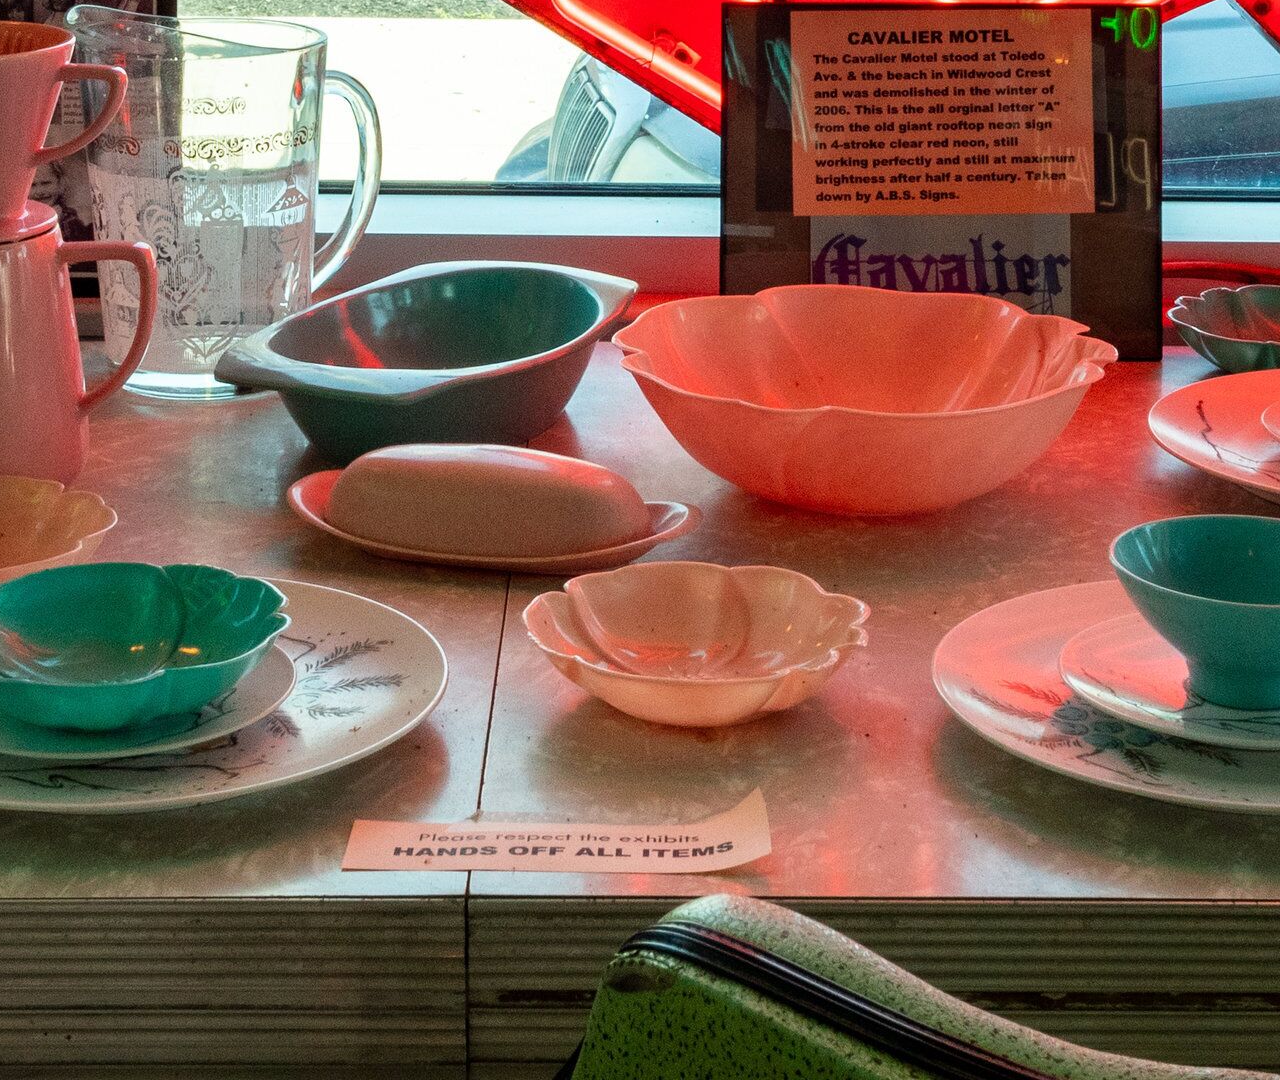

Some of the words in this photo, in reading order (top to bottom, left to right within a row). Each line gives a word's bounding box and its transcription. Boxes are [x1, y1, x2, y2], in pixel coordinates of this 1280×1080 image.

[848, 30, 942, 45] CAVALIER
[949, 29, 1014, 43] MOTEL
[812, 53, 839, 65] The
[841, 52, 898, 65] Cavalier
[900, 51, 938, 64] Motel
[941, 51, 980, 63] stood
[982, 51, 997, 62] at
[999, 50, 1046, 62] Toledo
[813, 71, 843, 82] Ave.
[846, 70, 857, 82] &
[860, 70, 884, 81] the
[886, 69, 928, 81] beach
[930, 69, 944, 80] in
[946, 68, 1012, 80] Wildwood
[1014, 67, 1052, 79] Crest
[813, 87, 839, 99] and
[841, 89, 870, 99] was
[872, 85, 950, 98] demolished
[952, 86, 966, 97] in
[969, 85, 992, 97] the
[994, 85, 1038, 96] winter
[1041, 84, 1055, 95] of
[814, 104, 851, 116] 2006.
[853, 104, 884, 116] This
[886, 104, 899, 115] is
[901, 104, 925, 115] the
[927, 103, 945, 114] all
[947, 102, 995, 116] orginal
[997, 102, 1036, 113] letter
[1037, 101, 1061, 112] "A"
[814, 122, 846, 133] from
[848, 121, 871, 133] the
[873, 121, 895, 132] old
[898, 121, 933, 135] giant
[936, 119, 985, 133] rooftop
[987, 121, 1021, 131] neon
[1024, 118, 1054, 133] sign
[814, 141, 828, 150] in
[830, 138, 886, 151] 4-stroke
[889, 138, 925, 150] clear
[926, 137, 950, 149] red
[952, 139, 990, 150] neon,
[993, 136, 1019, 148] still
[814, 156, 869, 170] working
[872, 155, 933, 169] perfectly
[935, 154, 961, 166] and
[963, 154, 990, 166] still
[993, 154, 1007, 165] at
[1010, 154, 1077, 165] maximum
[815, 173, 886, 188] brightness
[889, 172, 922, 184] after
[924, 171, 951, 183] half
[953, 174, 963, 183] a
[965, 171, 1021, 184] century.
[1024, 169, 1067, 182] Taken
[815, 191, 852, 202] down
[855, 190, 872, 204] by
[874, 189, 916, 201] A.B.S.
[919, 189, 960, 203] Signs.
[813, 233, 1070, 296] Cavalier
[418, 833, 486, 842] Please
[495, 833, 572, 843] respect
[580, 834, 611, 842] the
[619, 834, 700, 844] exhibits
[393, 846, 498, 857] HANDS
[508, 846, 566, 857] OFF
[574, 846, 632, 858] ALL
[641, 841, 735, 859] ITEMS
